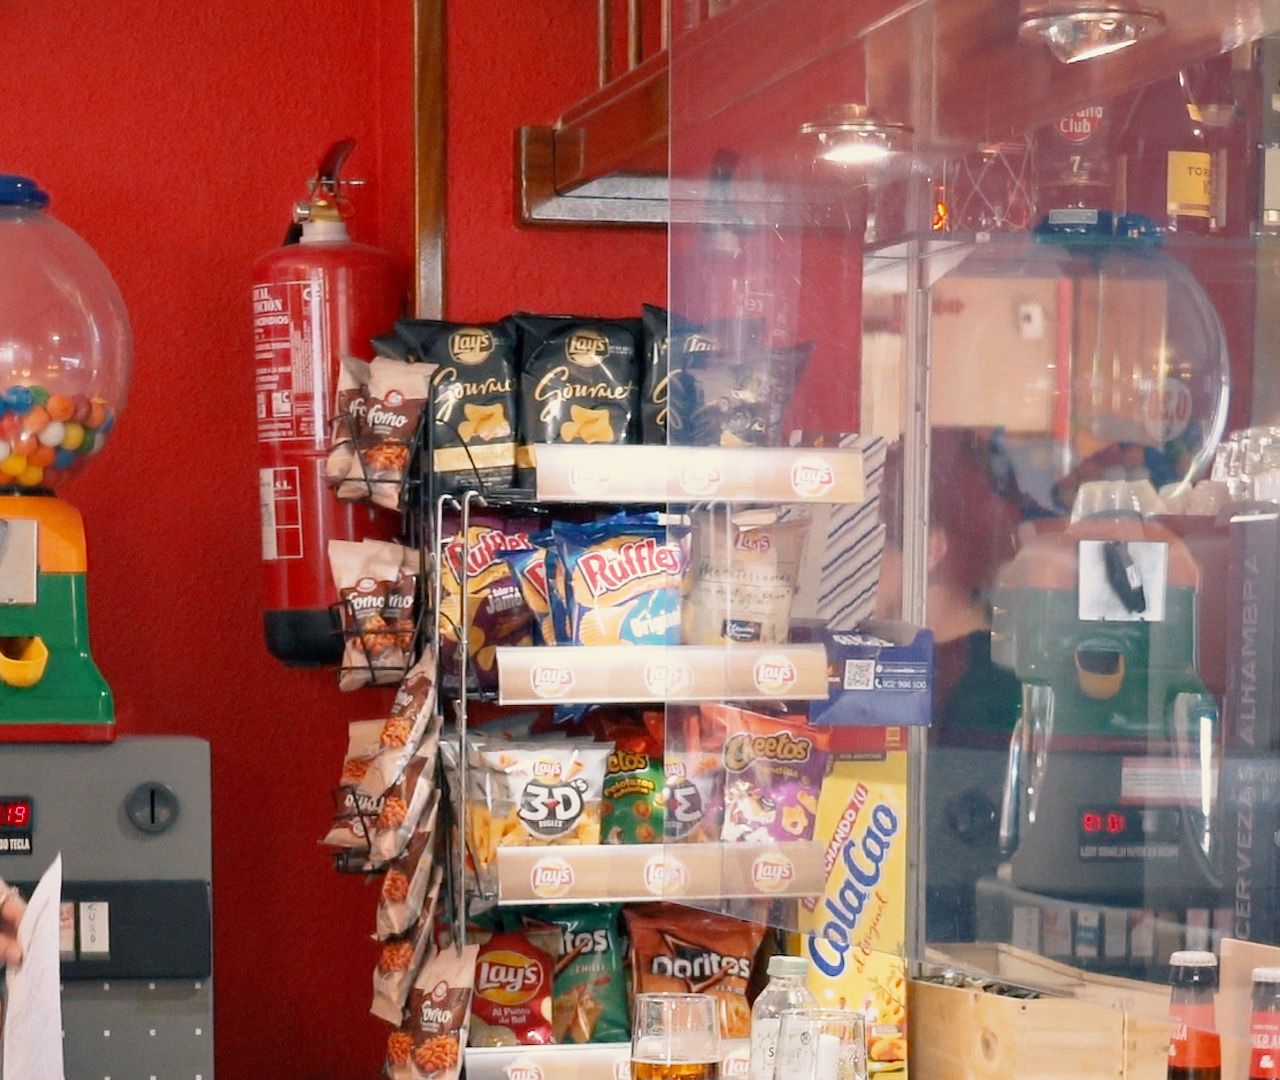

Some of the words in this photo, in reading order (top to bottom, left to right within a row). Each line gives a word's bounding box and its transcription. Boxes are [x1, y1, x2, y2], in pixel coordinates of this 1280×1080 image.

[1060, 117, 1091, 133] Club
[1187, 165, 1211, 176] TOR
[535, 366, 638, 422] Gourmet
[577, 538, 681, 599] Ruffles
[1241, 553, 1260, 747] ALHAMBRA
[533, 760, 563, 777] Lay's
[606, 750, 647, 773] etos
[9, 838, 31, 851] TECLA
[808, 803, 899, 978] ColaCao
[478, 962, 539, 992] Lay's
